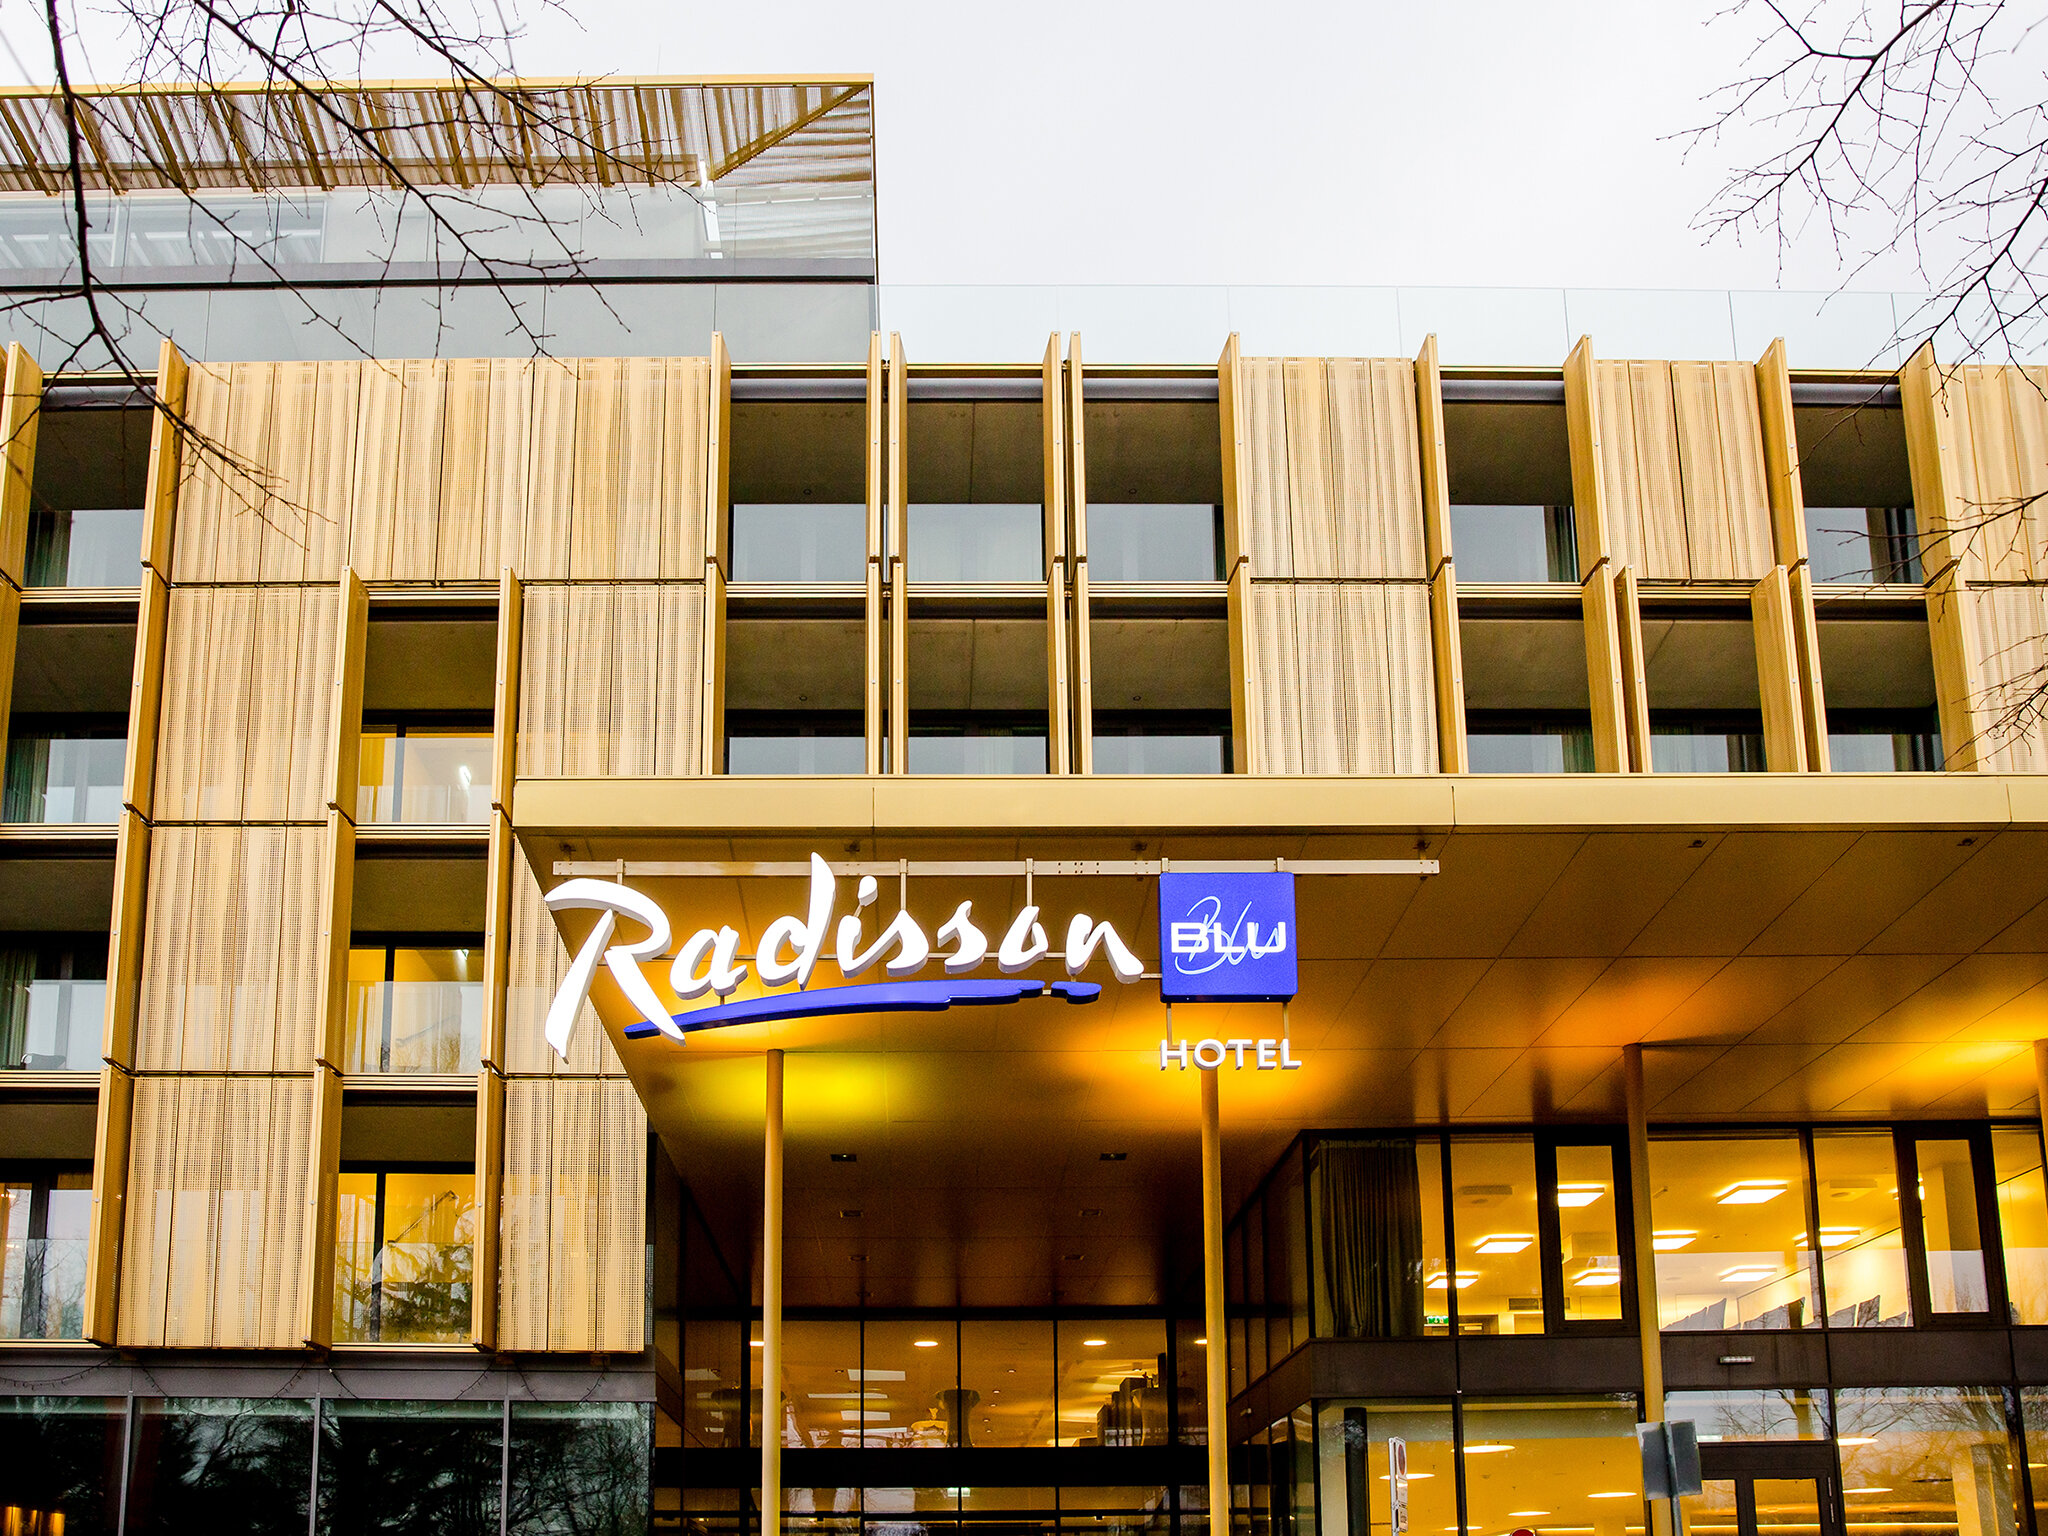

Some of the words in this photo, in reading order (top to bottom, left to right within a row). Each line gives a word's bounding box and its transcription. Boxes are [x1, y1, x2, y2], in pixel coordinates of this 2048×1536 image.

[1170, 921, 1287, 953] BLU
[544, 852, 1144, 1064] Radisson
[1160, 1038, 1302, 1071] HOTEL
